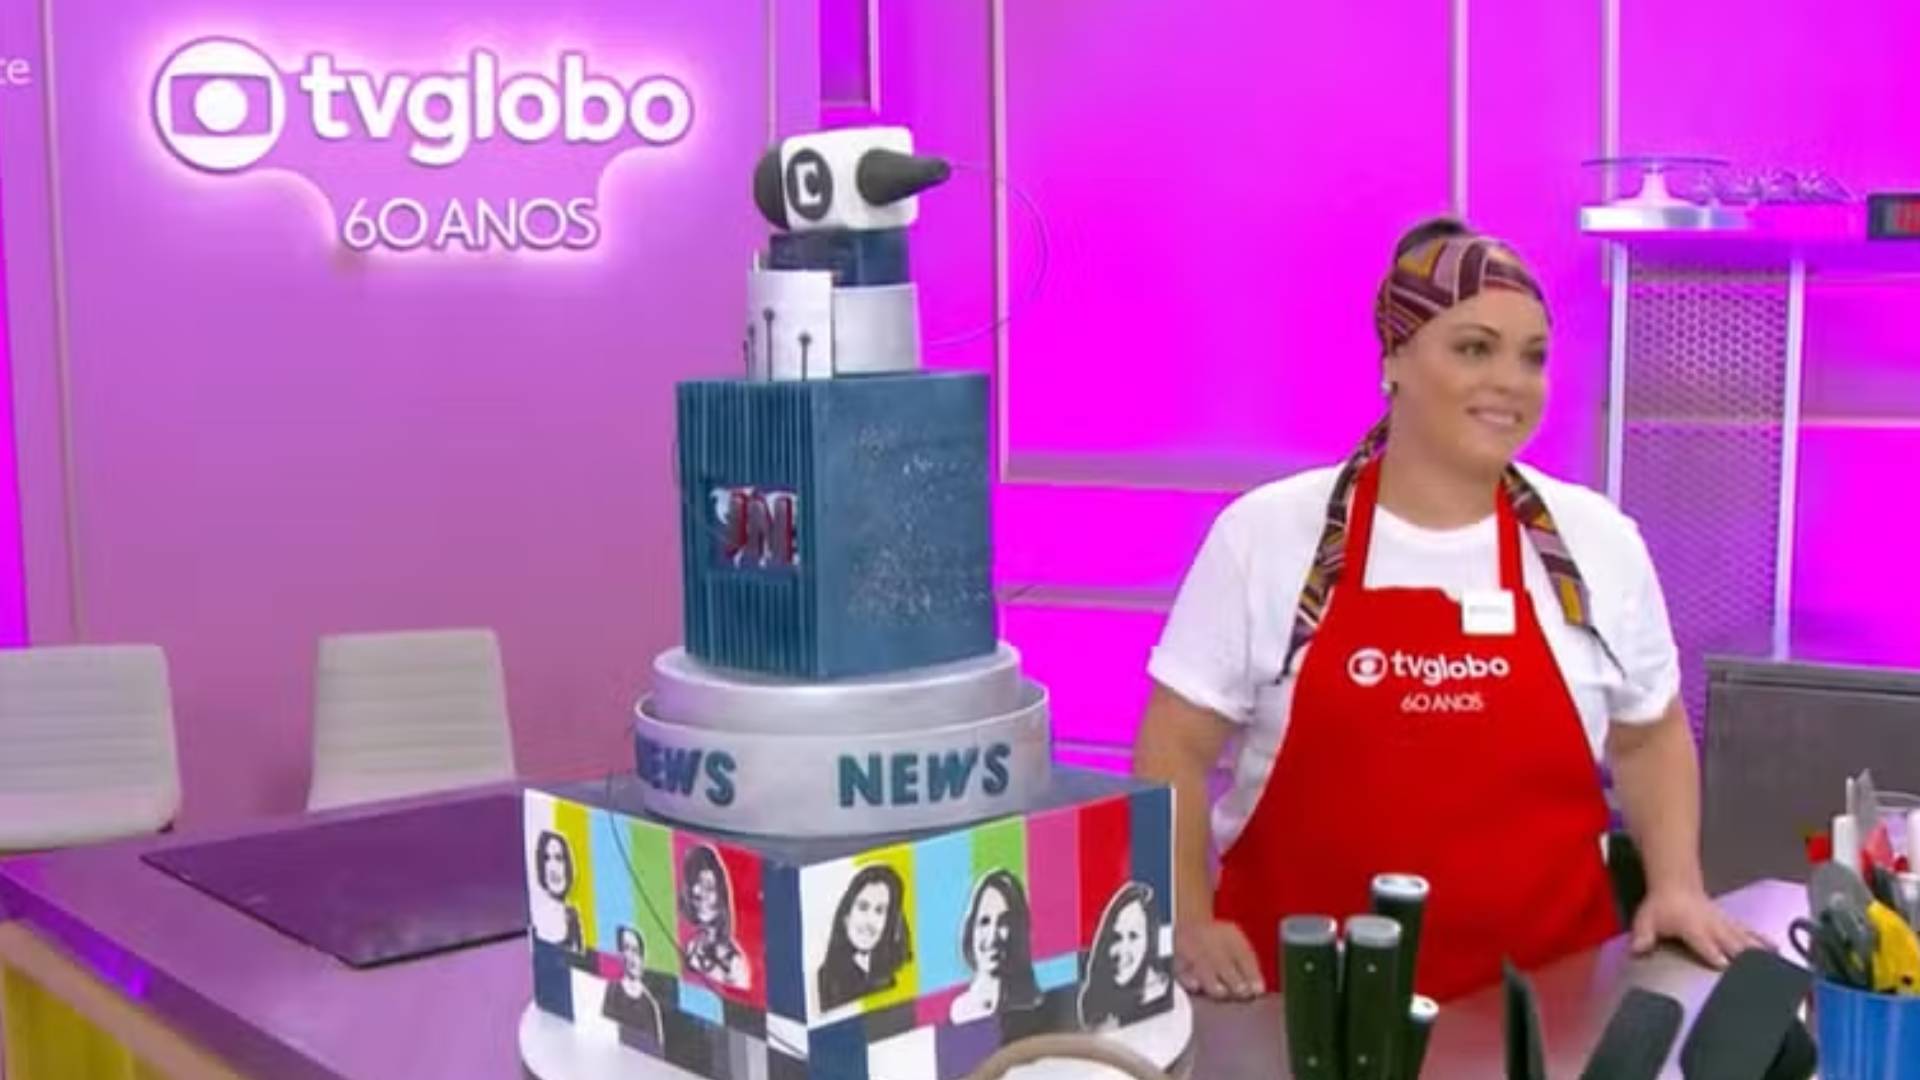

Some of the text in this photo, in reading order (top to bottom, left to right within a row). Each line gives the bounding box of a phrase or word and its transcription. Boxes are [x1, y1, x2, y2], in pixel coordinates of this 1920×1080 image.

[300, 49, 693, 167] tvglobo
[342, 197, 599, 249] 60 ANOS
[1390, 649, 1510, 686] tvglobo
[1400, 691, 1484, 713] 60 ANOS
[838, 743, 1011, 807] NEWS
